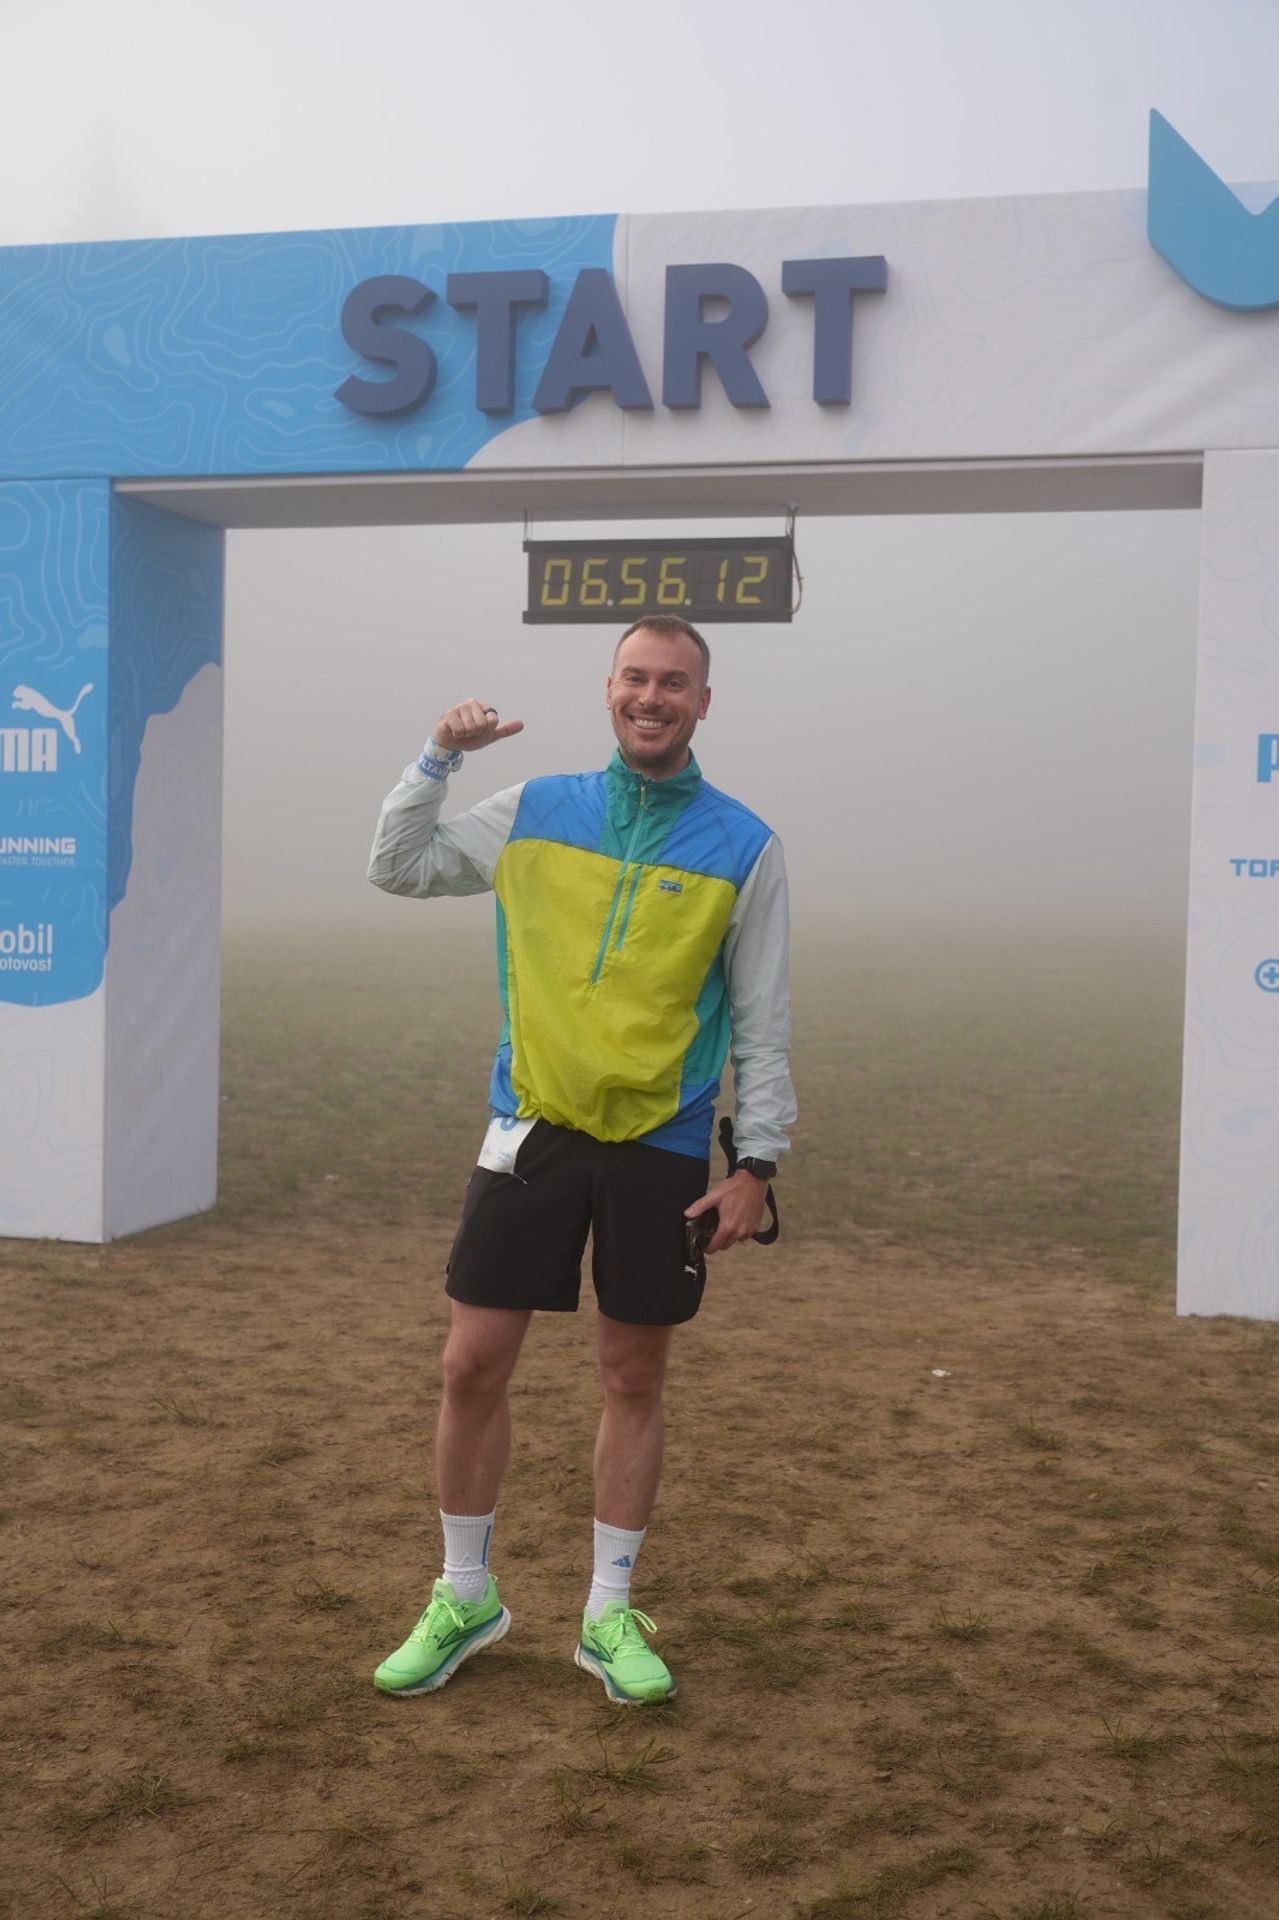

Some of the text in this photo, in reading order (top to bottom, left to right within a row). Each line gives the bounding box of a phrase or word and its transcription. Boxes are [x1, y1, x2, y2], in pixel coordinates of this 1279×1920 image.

[333, 255, 888, 419] START
[0, 922, 53, 954] obil
[0, 956, 52, 971] otovost
